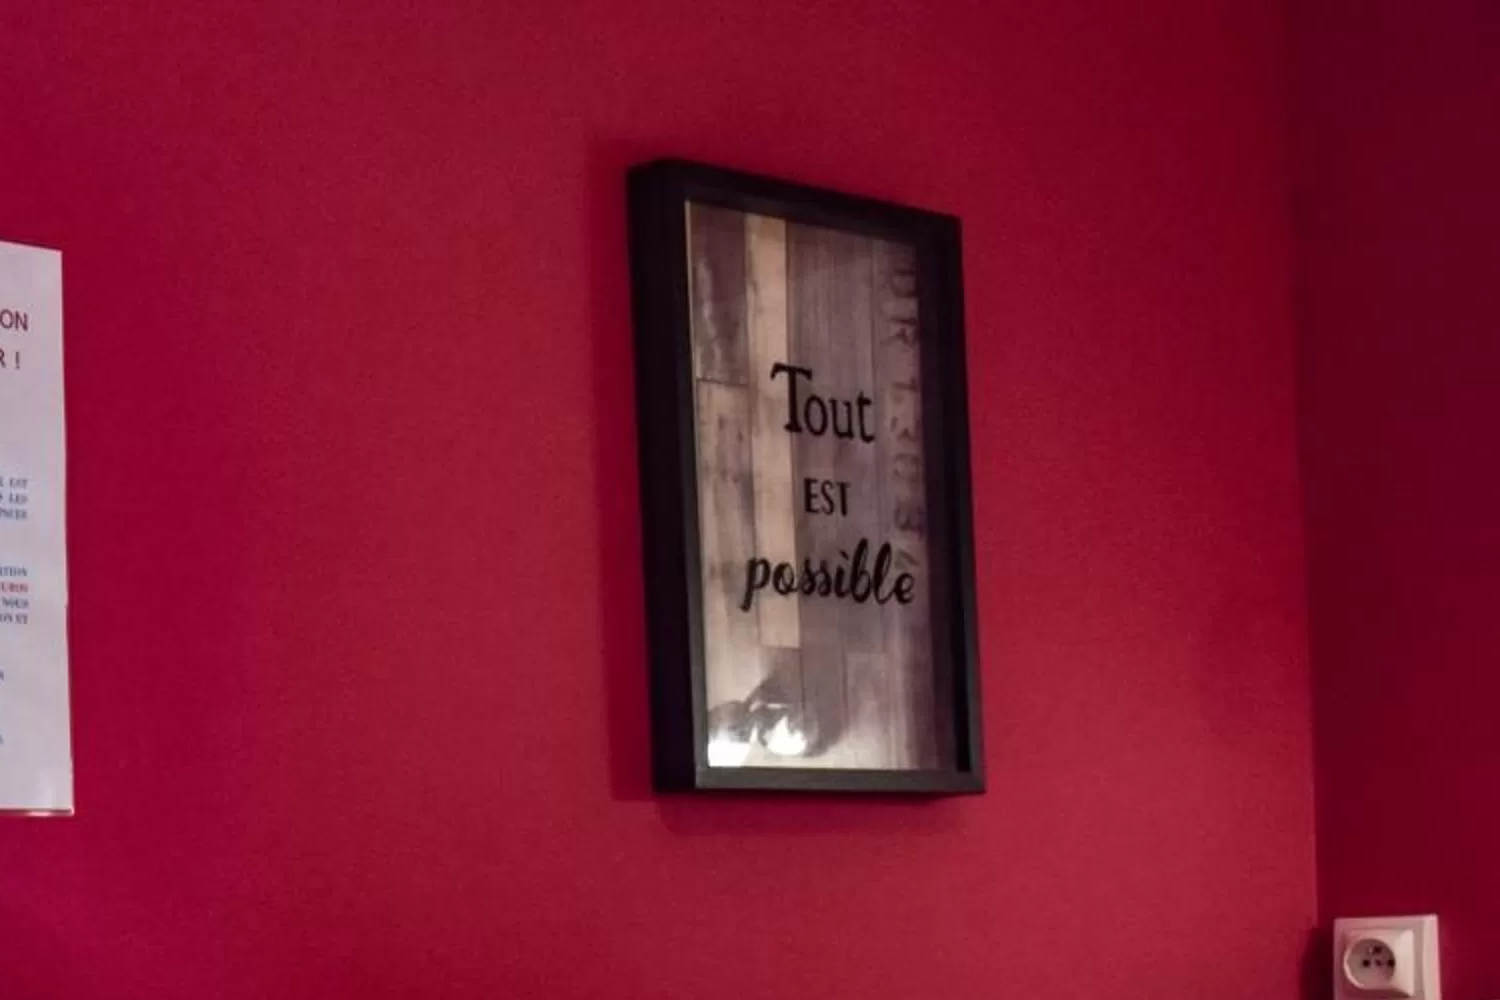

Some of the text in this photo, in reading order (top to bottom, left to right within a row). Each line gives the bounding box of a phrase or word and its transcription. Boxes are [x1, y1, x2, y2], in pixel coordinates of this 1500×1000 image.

[15, 351, 20, 370] !
[770, 362, 876, 445] Tout
[804, 478, 851, 518] EST
[739, 538, 917, 611] possible
